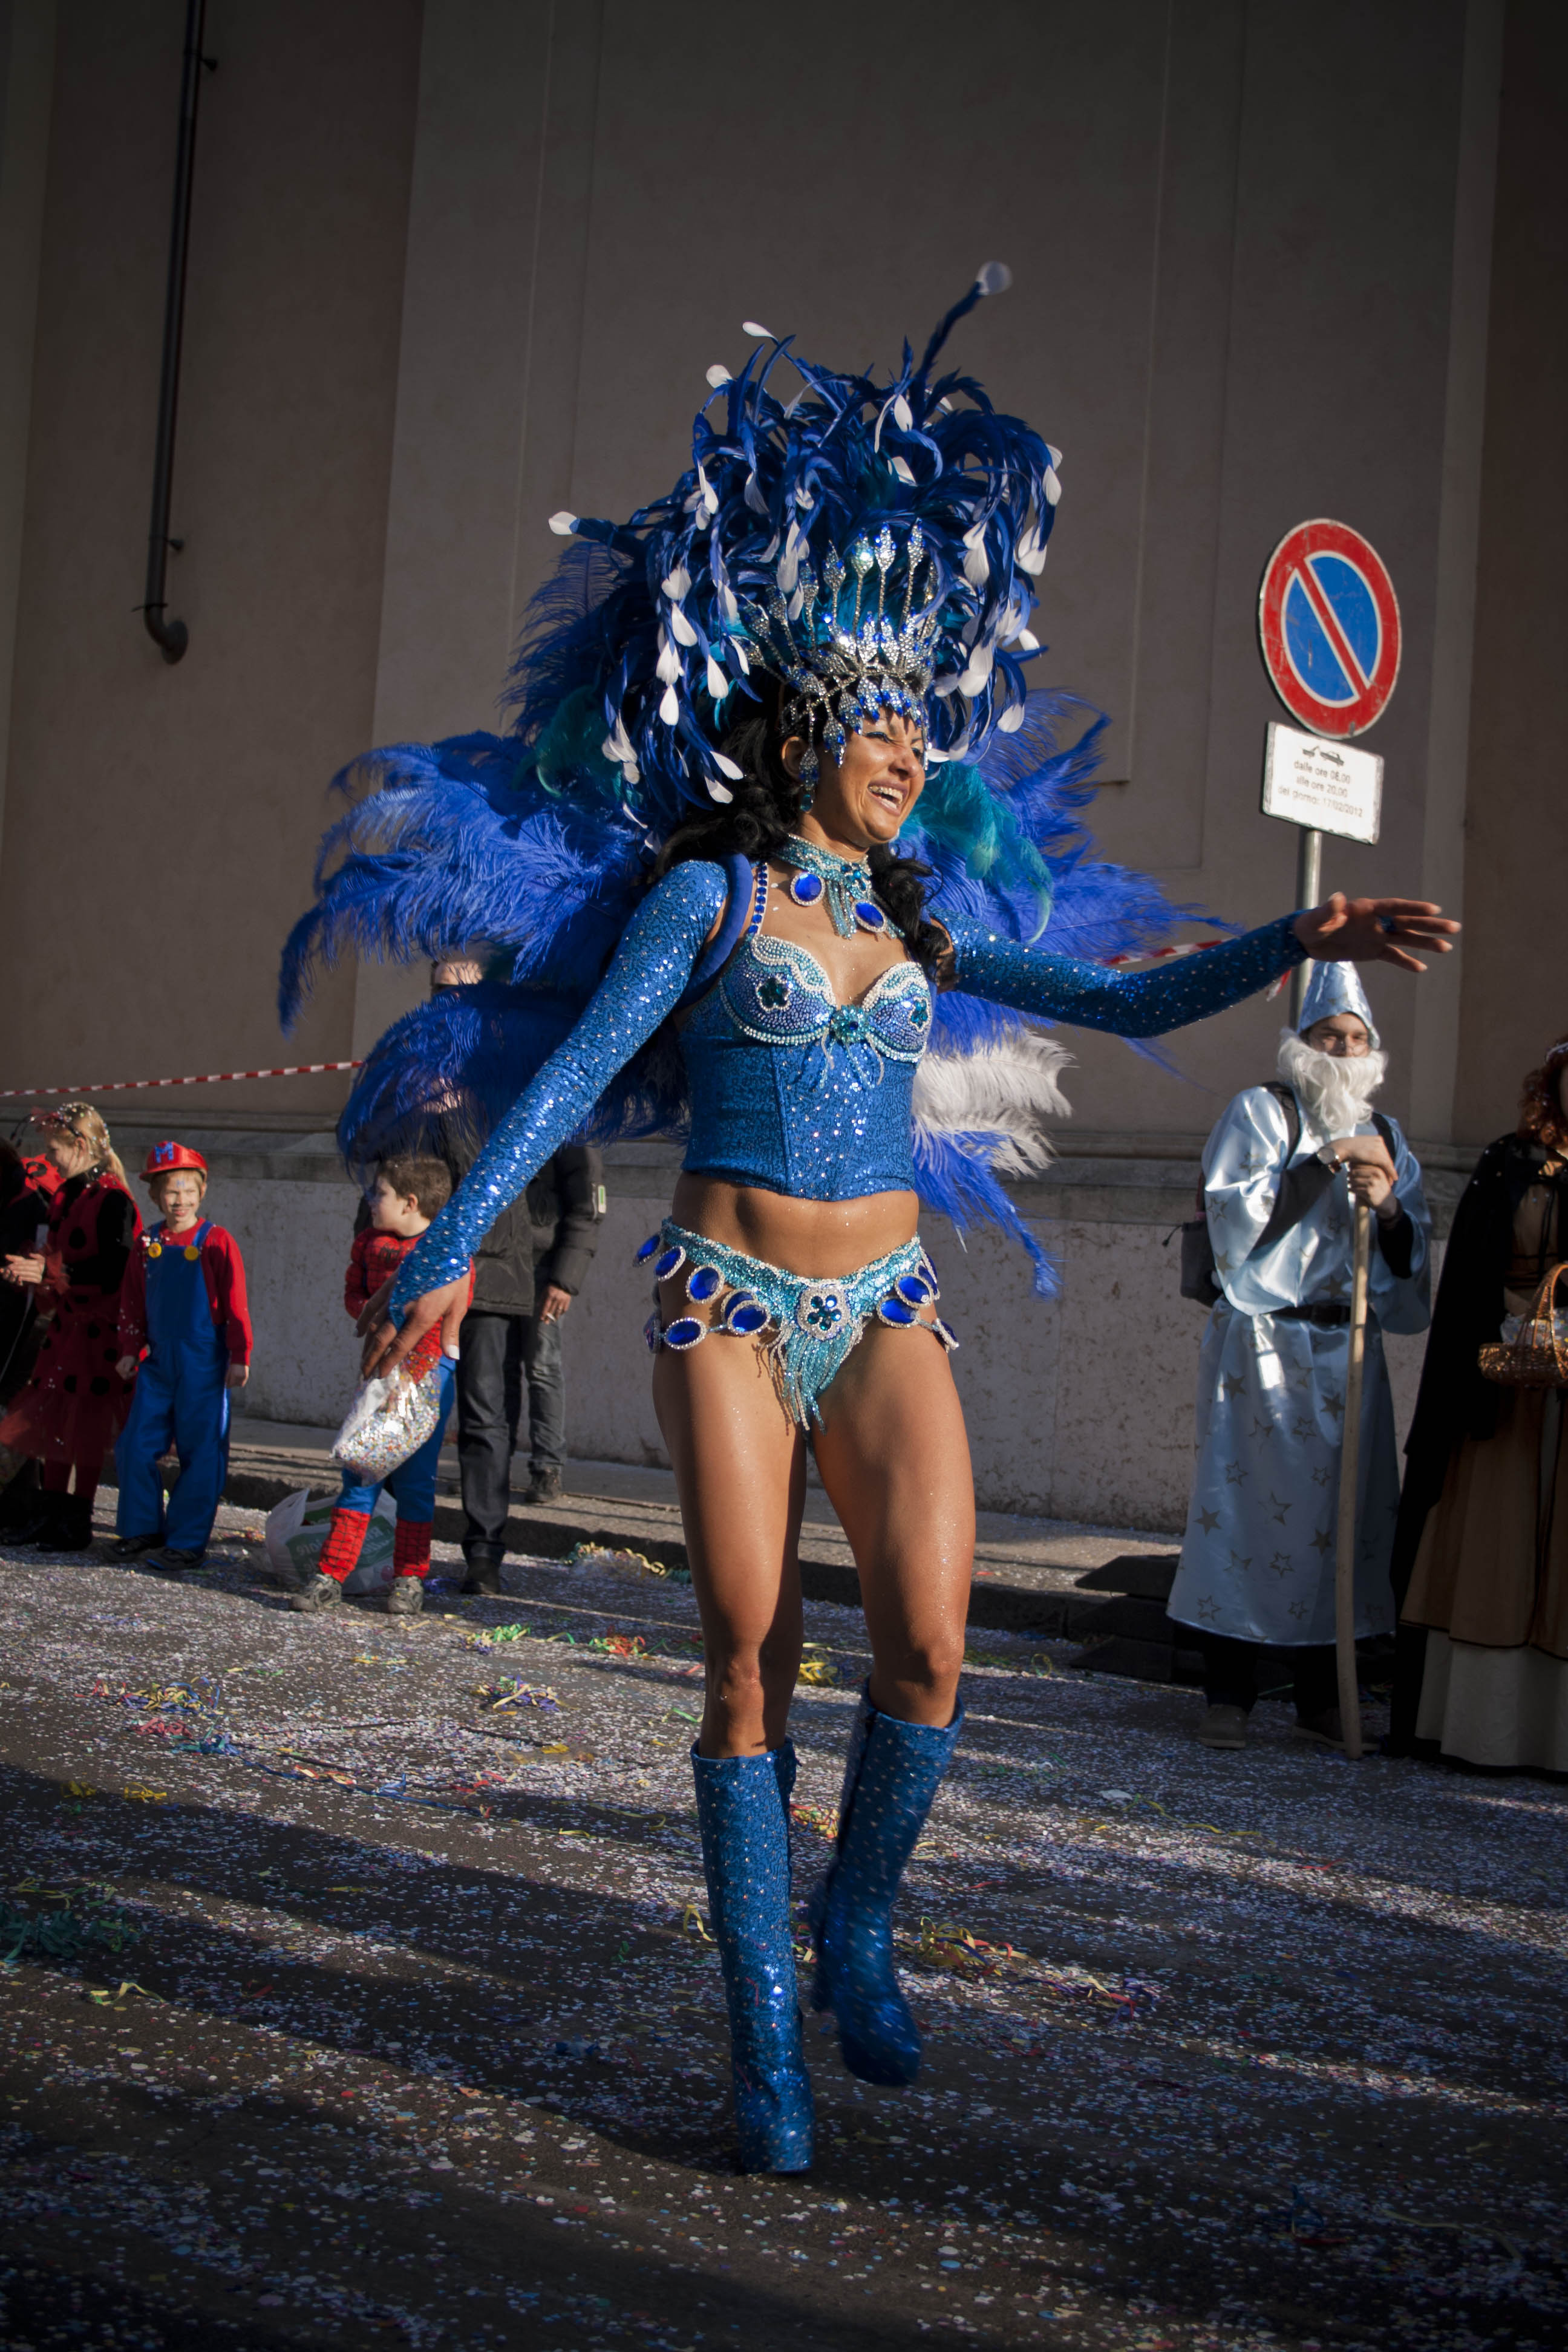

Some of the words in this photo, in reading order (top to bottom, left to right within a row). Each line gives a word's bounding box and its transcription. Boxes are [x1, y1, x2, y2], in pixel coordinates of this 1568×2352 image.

[1294, 760, 1312, 773] dalle
[1315, 768, 1328, 778] ore
[1278, 785, 1290, 796] del
[1312, 781, 1324, 792] ore
[1327, 785, 1348, 797] 20.00
[154, 1142, 174, 1163] M
